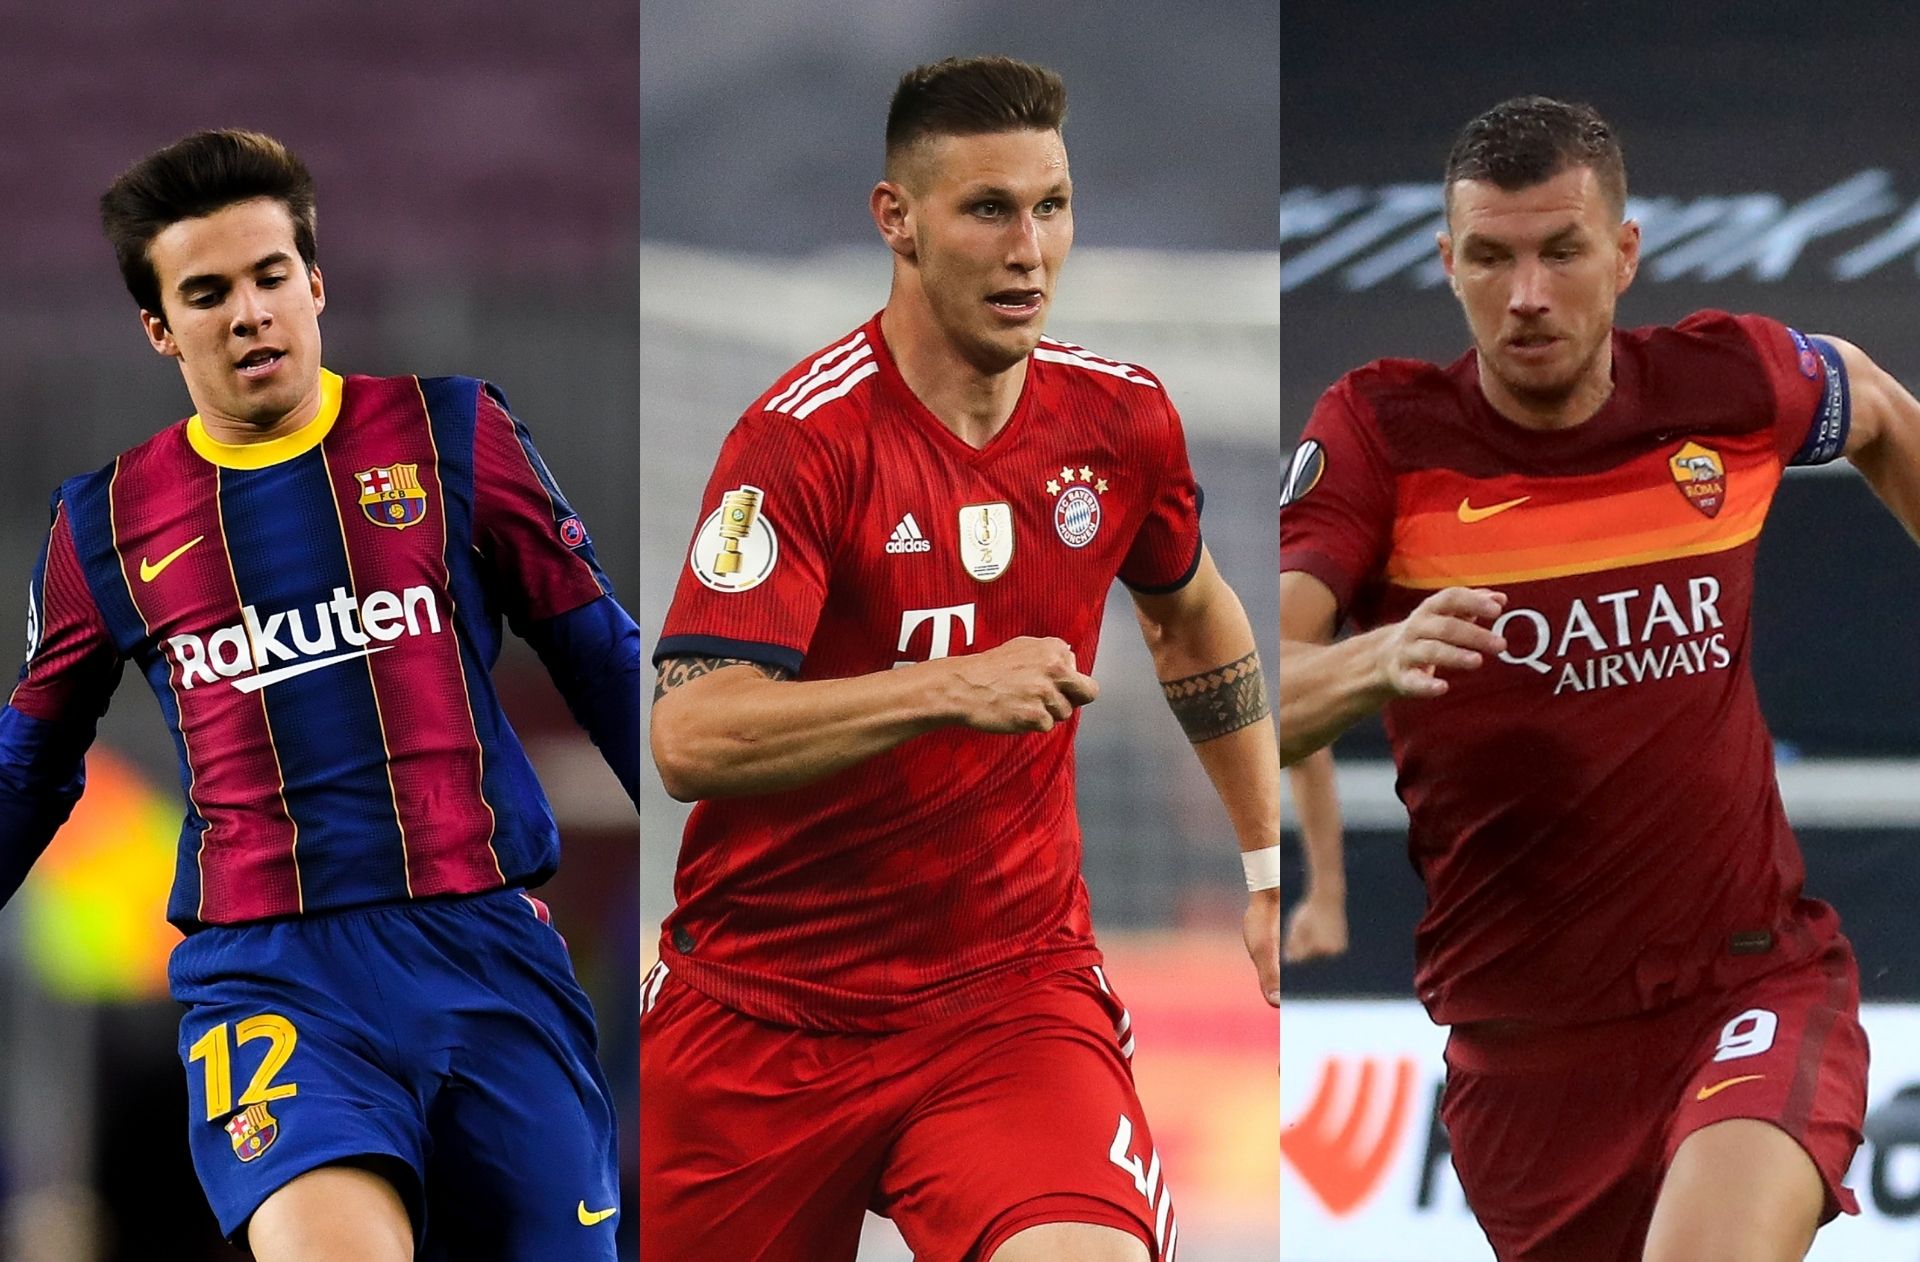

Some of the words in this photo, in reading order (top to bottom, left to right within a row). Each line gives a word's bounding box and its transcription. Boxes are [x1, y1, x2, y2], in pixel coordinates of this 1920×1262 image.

[380, 490, 406, 501] FCB
[1068, 490, 1097, 513] BAYERN
[1685, 483, 1723, 497] ROMA
[885, 539, 931, 553] adidas
[167, 585, 442, 690] Rakuten
[1491, 576, 1723, 674] QATAR
[1553, 633, 1730, 695] AIRWAYS
[1713, 1008, 1778, 1062] 9
[188, 1013, 297, 1122] 12
[1108, 1113, 1147, 1198] 4
